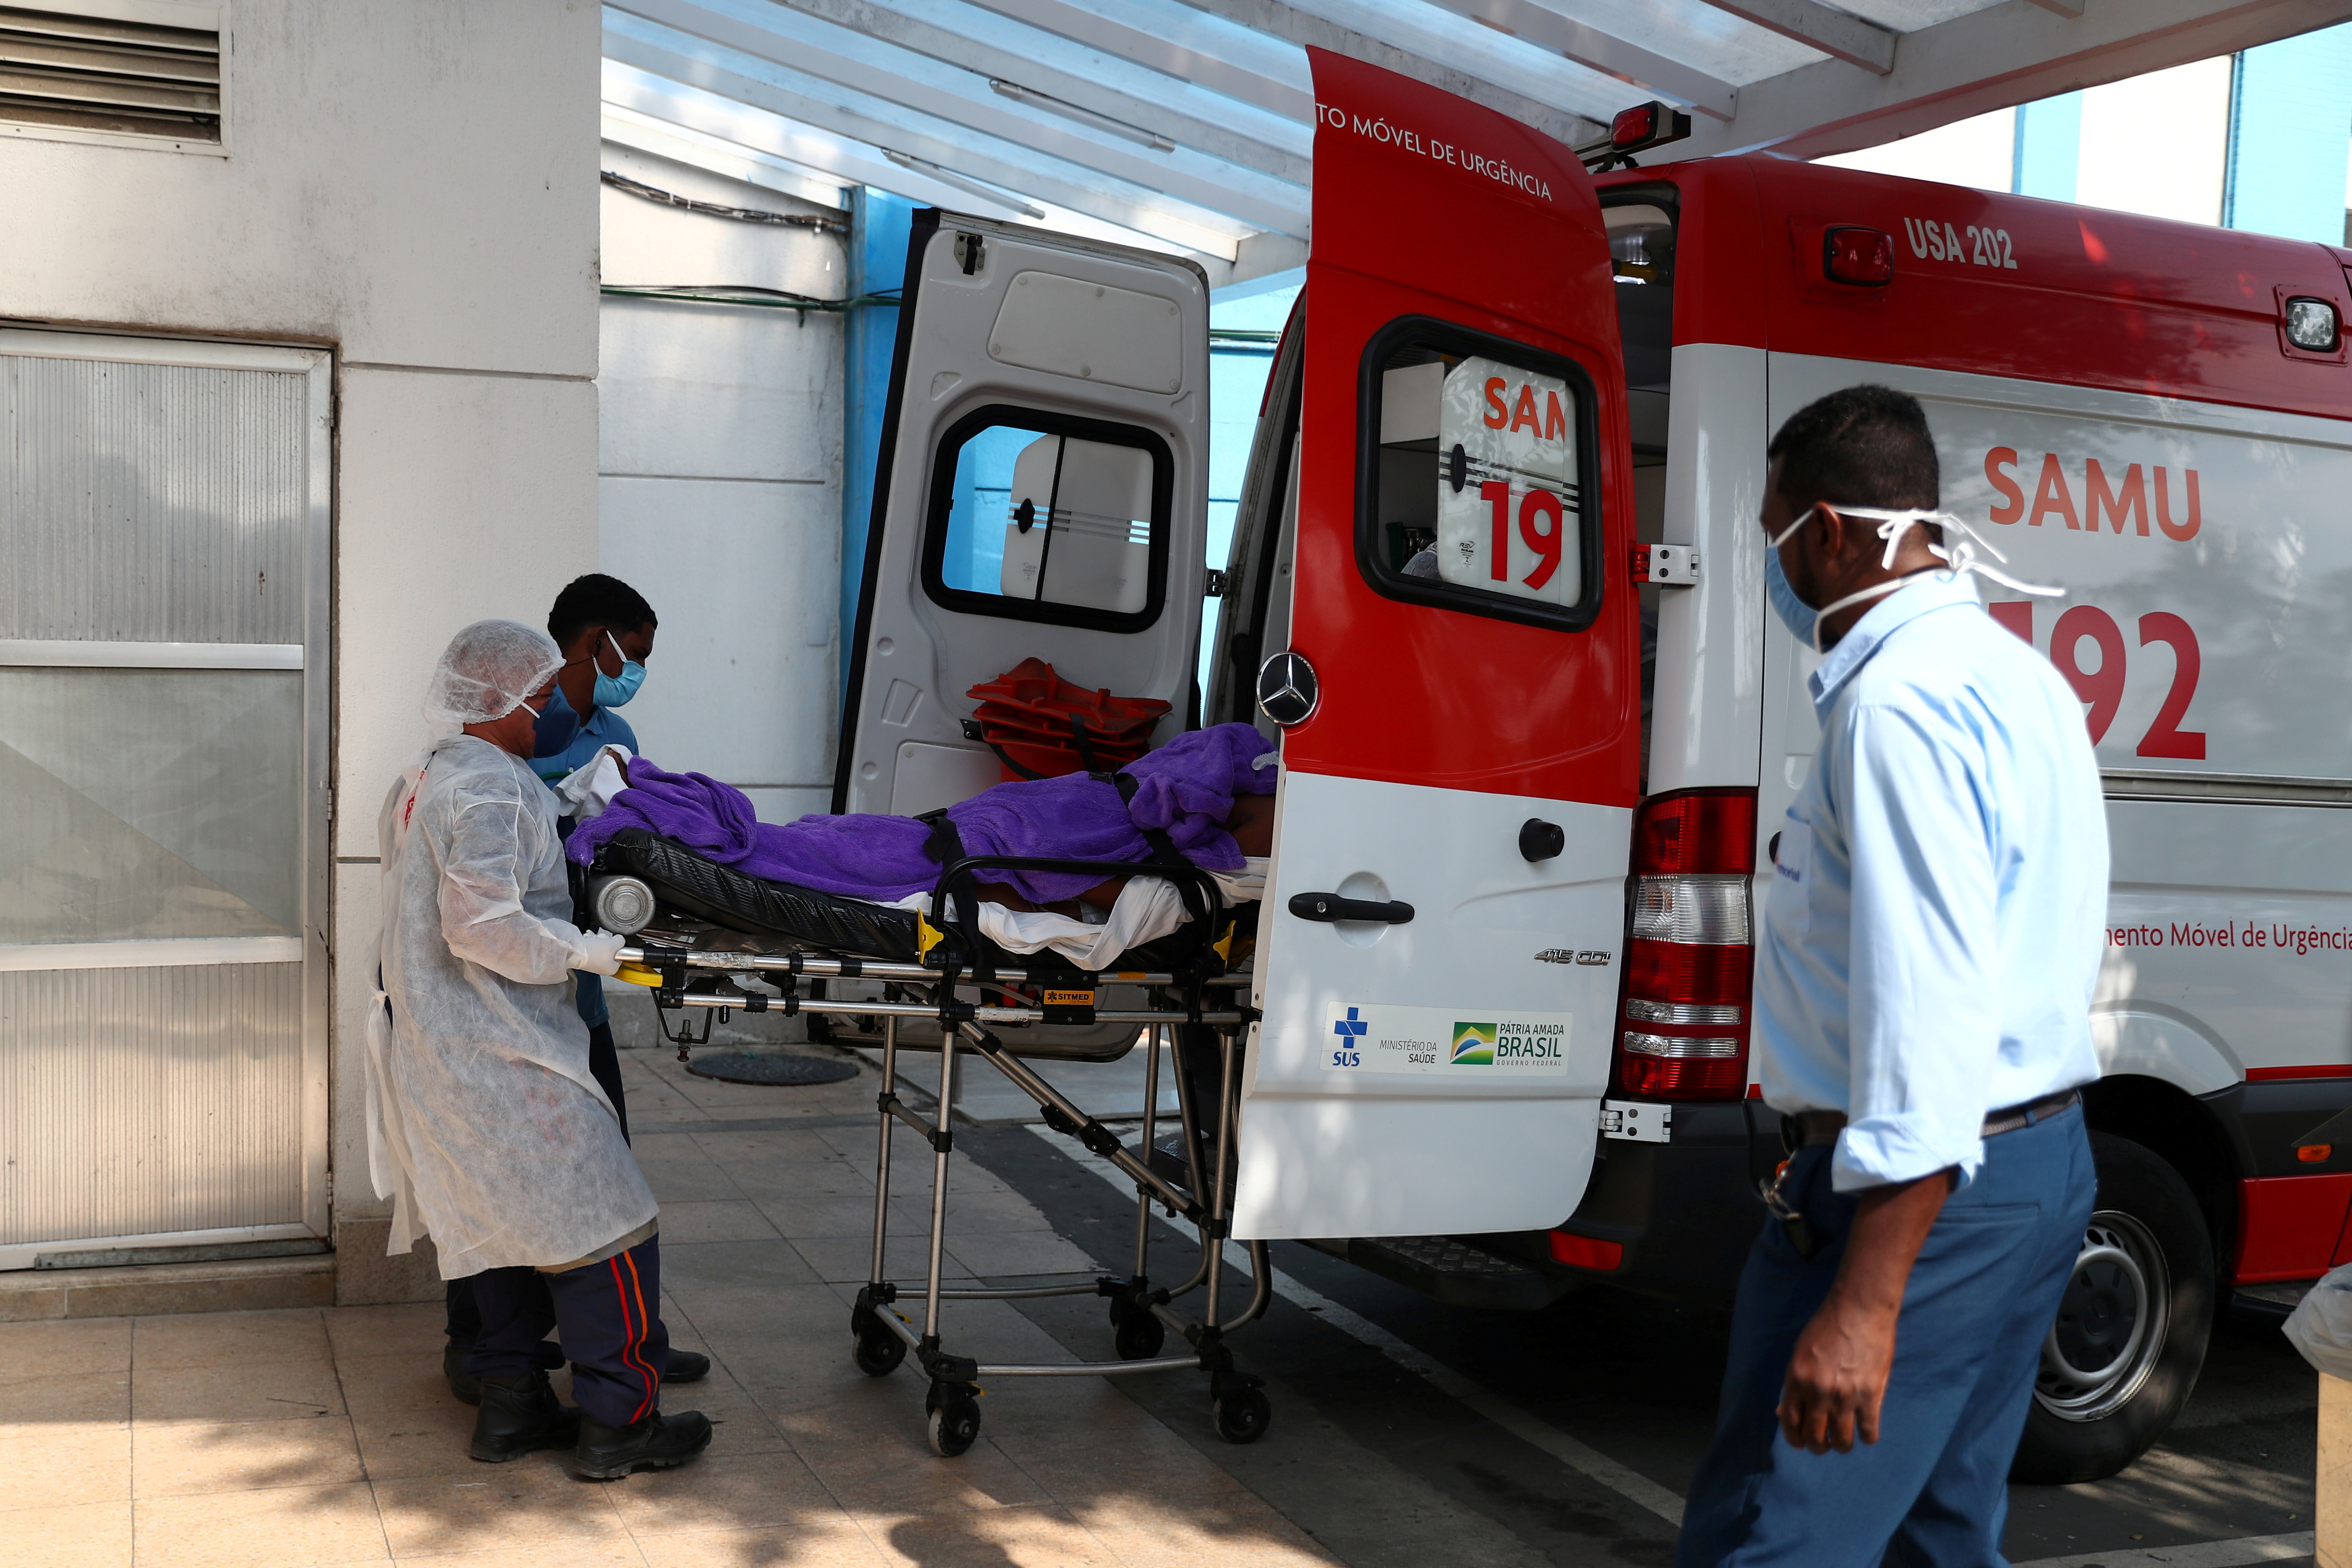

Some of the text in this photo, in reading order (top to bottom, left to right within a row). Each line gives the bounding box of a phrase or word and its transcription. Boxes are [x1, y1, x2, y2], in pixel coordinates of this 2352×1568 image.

[1316, 102, 1552, 202] TO MÓVEL DE URGÊNCIA
[1904, 217, 2018, 269] USA 202
[1984, 446, 2201, 542] SAMU
[1480, 480, 1563, 591] 19
[1988, 601, 2206, 760] 92
[2170, 920, 2235, 947] Móvel
[2242, 921, 2266, 947] de
[1534, 948, 1611, 966] 415 CDI
[1499, 1020, 1564, 1035] PÁTRIA AMADA
[1380, 1039, 1437, 1052] MINISTÉRIO DA
[1408, 1051, 1436, 1063] SAÚDE
[1497, 1036, 1562, 1058] BRASIL
[1332, 1051, 1360, 1067] SUS
